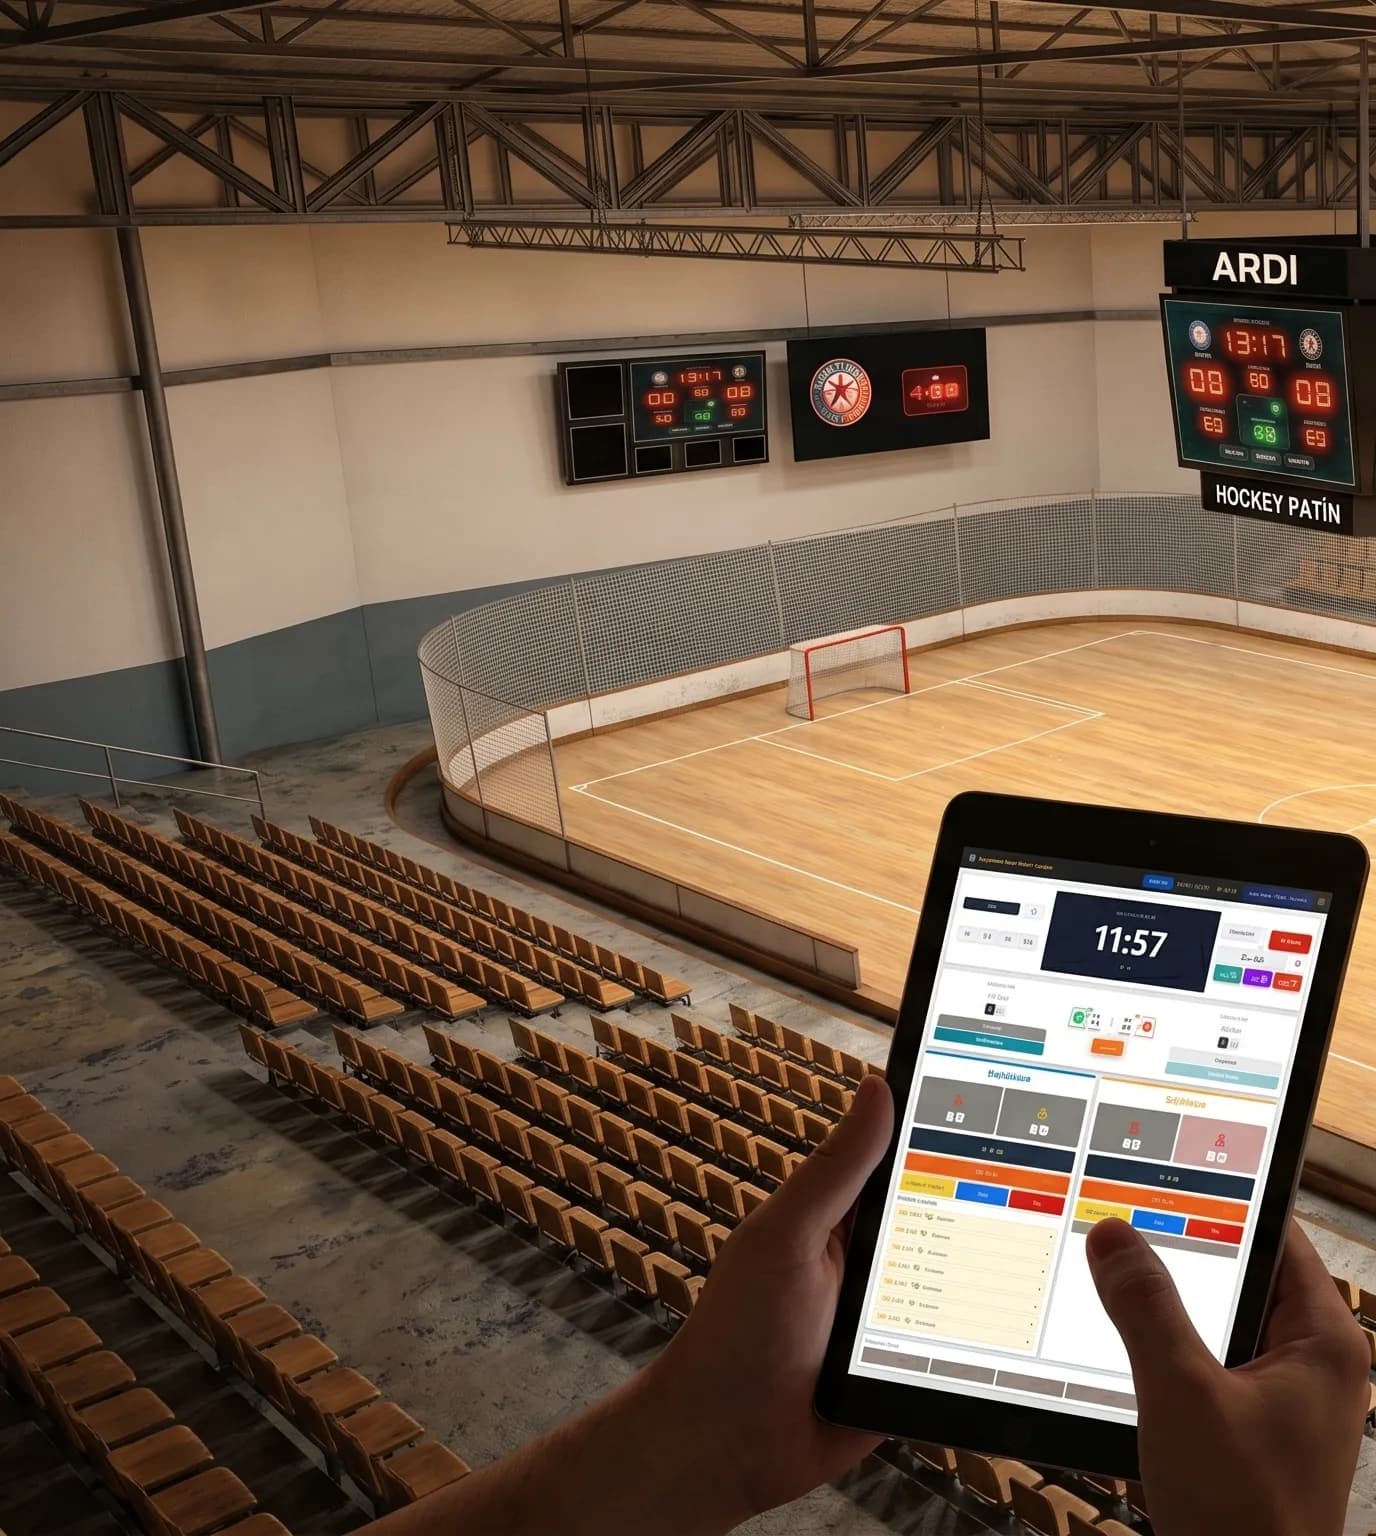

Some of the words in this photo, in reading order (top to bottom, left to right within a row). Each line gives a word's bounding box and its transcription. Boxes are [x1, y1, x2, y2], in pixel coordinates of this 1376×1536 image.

[1213, 252, 1297, 285] ARDI
[1227, 331, 1286, 358] 13:17
[1189, 368, 1224, 395] 08
[1295, 379, 1331, 407] 08
[1216, 484, 1284, 514] HOCKEY
[1288, 497, 1341, 525] PATÍN
[1095, 925, 1168, 959] 11:57
